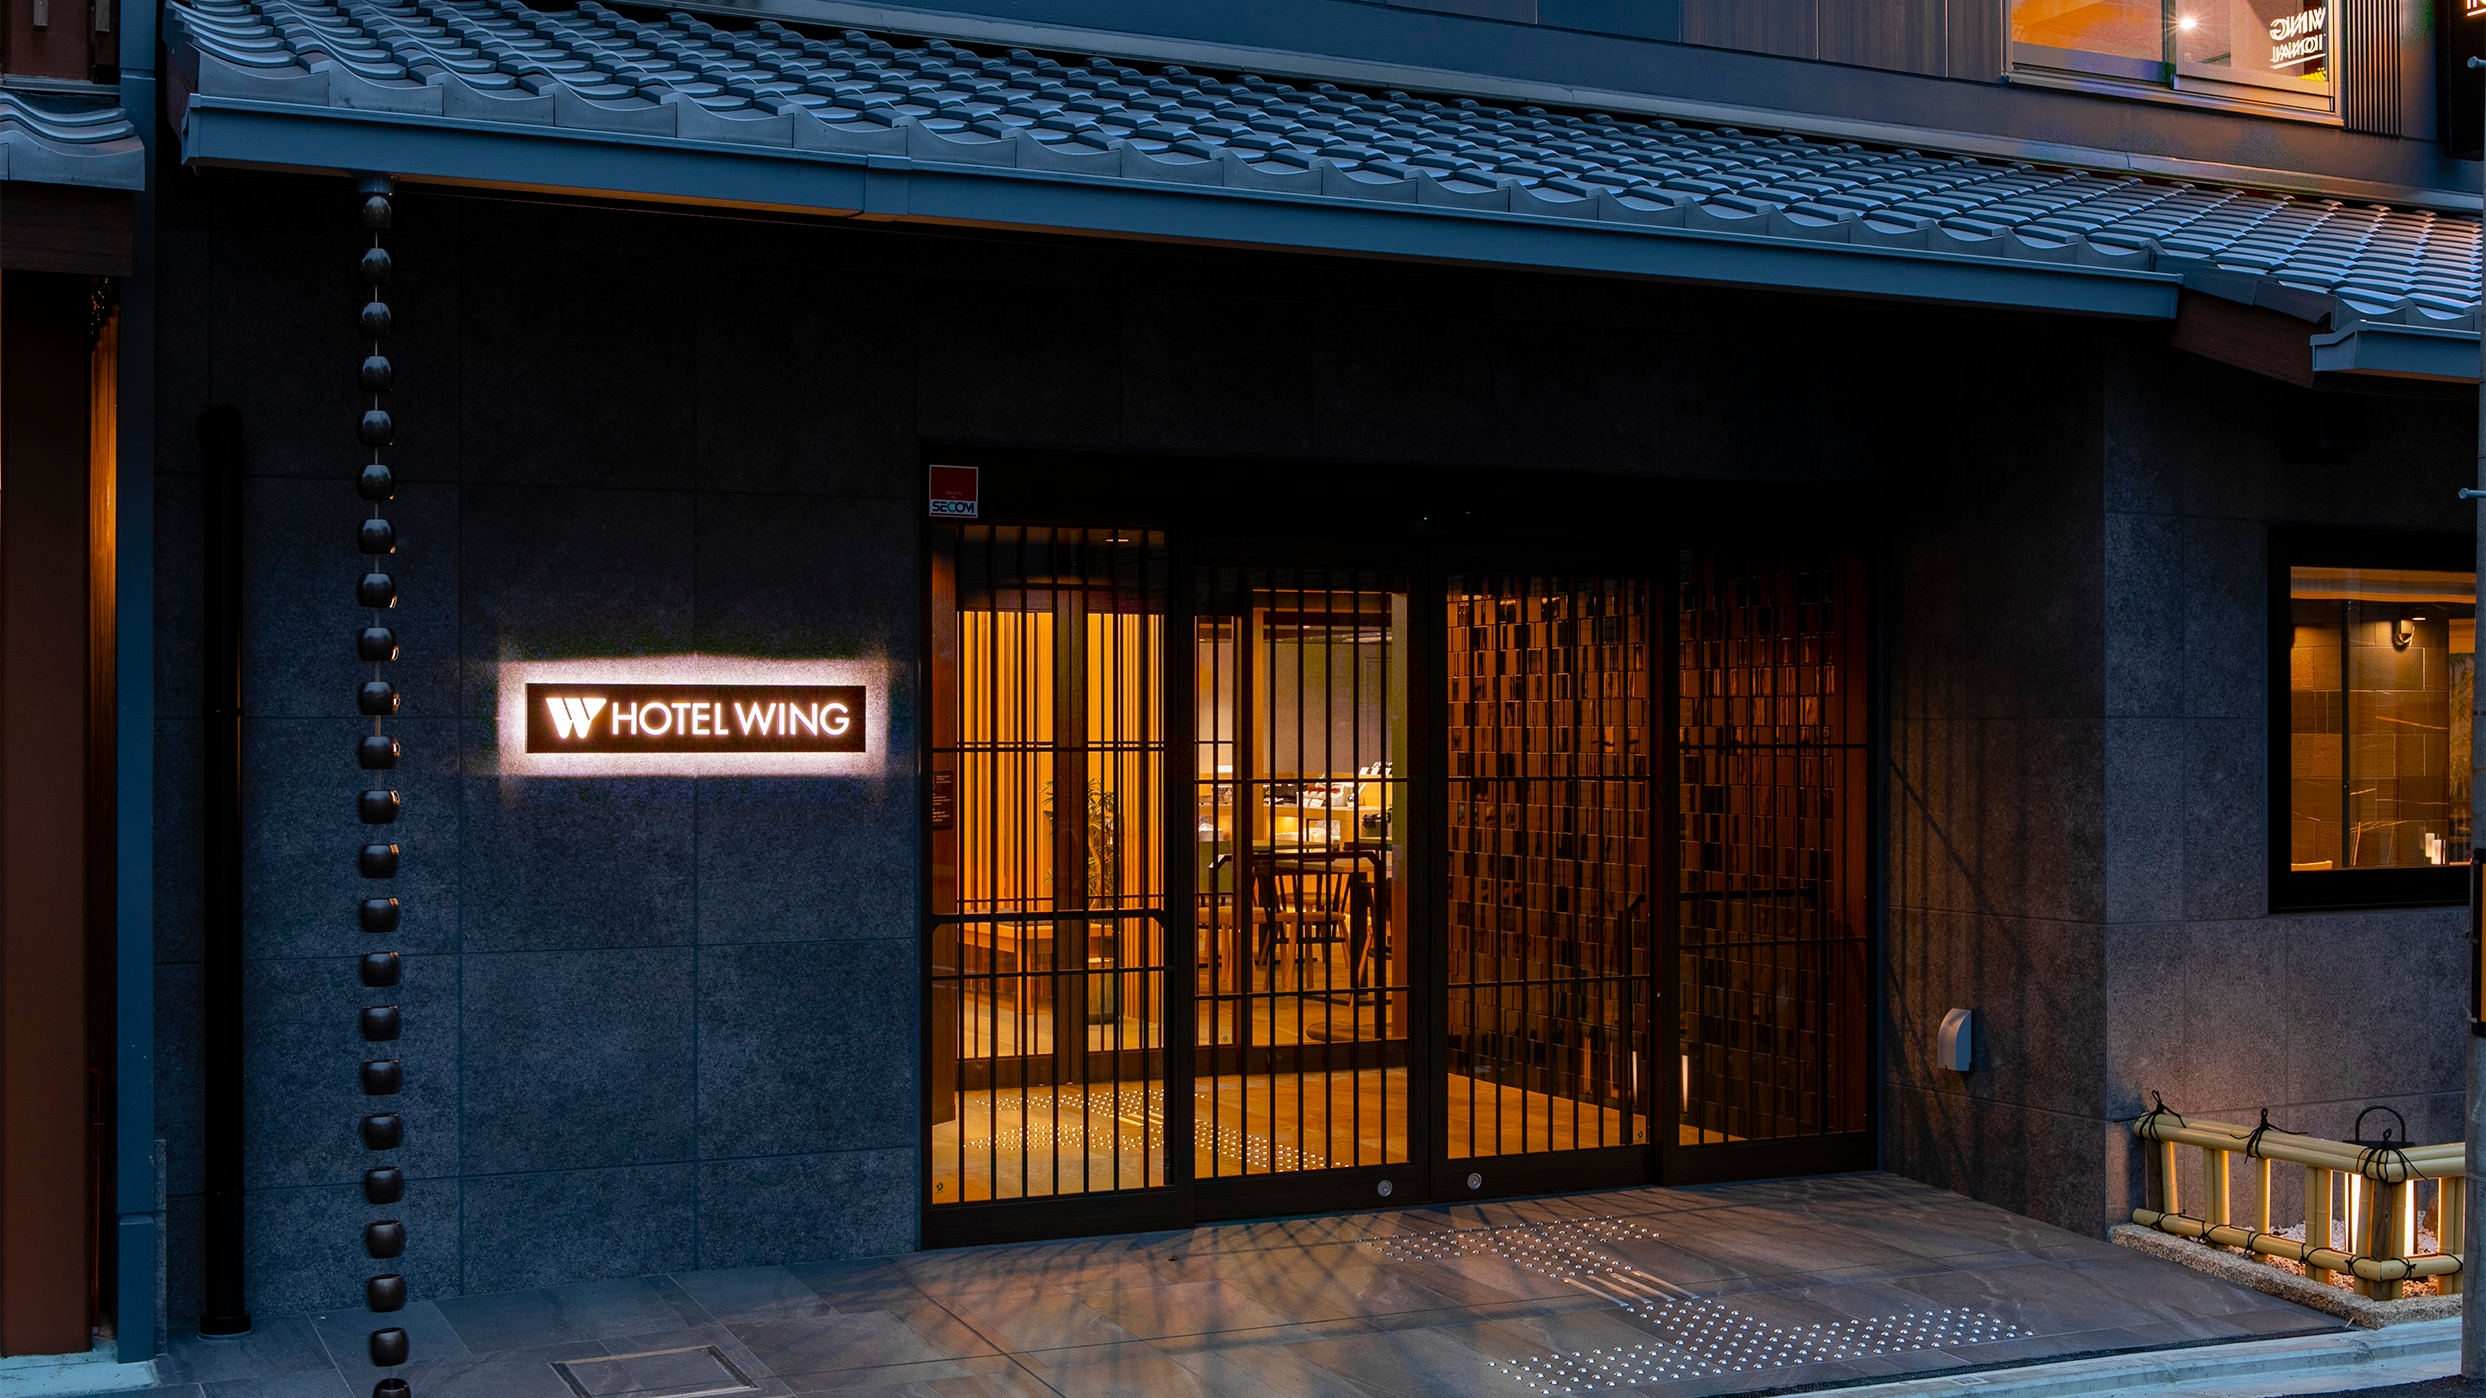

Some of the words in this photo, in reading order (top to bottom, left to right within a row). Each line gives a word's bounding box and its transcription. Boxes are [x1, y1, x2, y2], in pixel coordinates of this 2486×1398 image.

[933, 501, 974, 514] SECOM
[612, 702, 729, 736] HOTEL
[734, 701, 850, 736] WING
